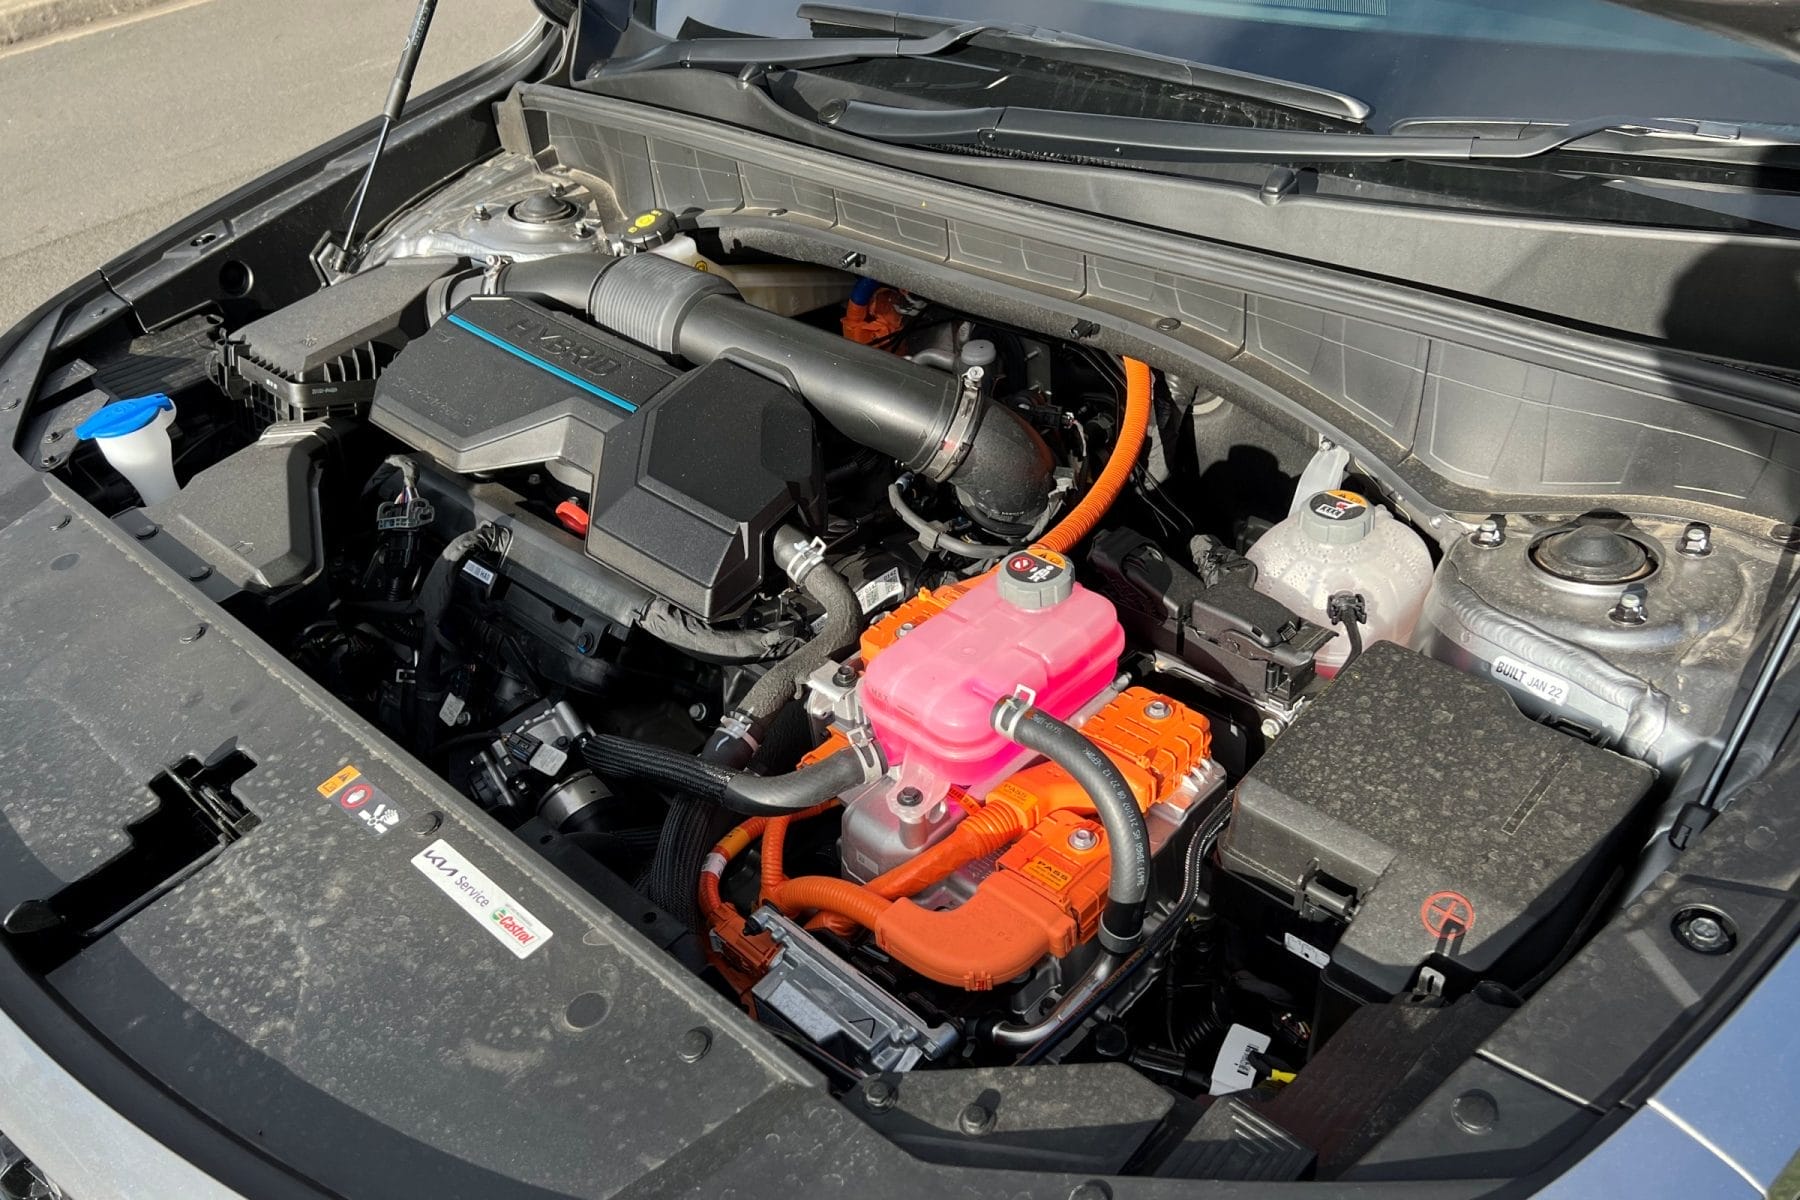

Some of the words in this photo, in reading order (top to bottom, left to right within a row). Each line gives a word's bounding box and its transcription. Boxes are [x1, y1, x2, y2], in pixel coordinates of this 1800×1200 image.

[504, 318, 622, 377] HYBRID
[1495, 661, 1527, 683] BUILT
[1527, 676, 1548, 692] JAN
[1547, 684, 1564, 699] 22
[423, 850, 458, 877] KIA
[455, 875, 490, 908] Service
[1037, 860, 1068, 881] PASS
[500, 916, 535, 944] Castrol
